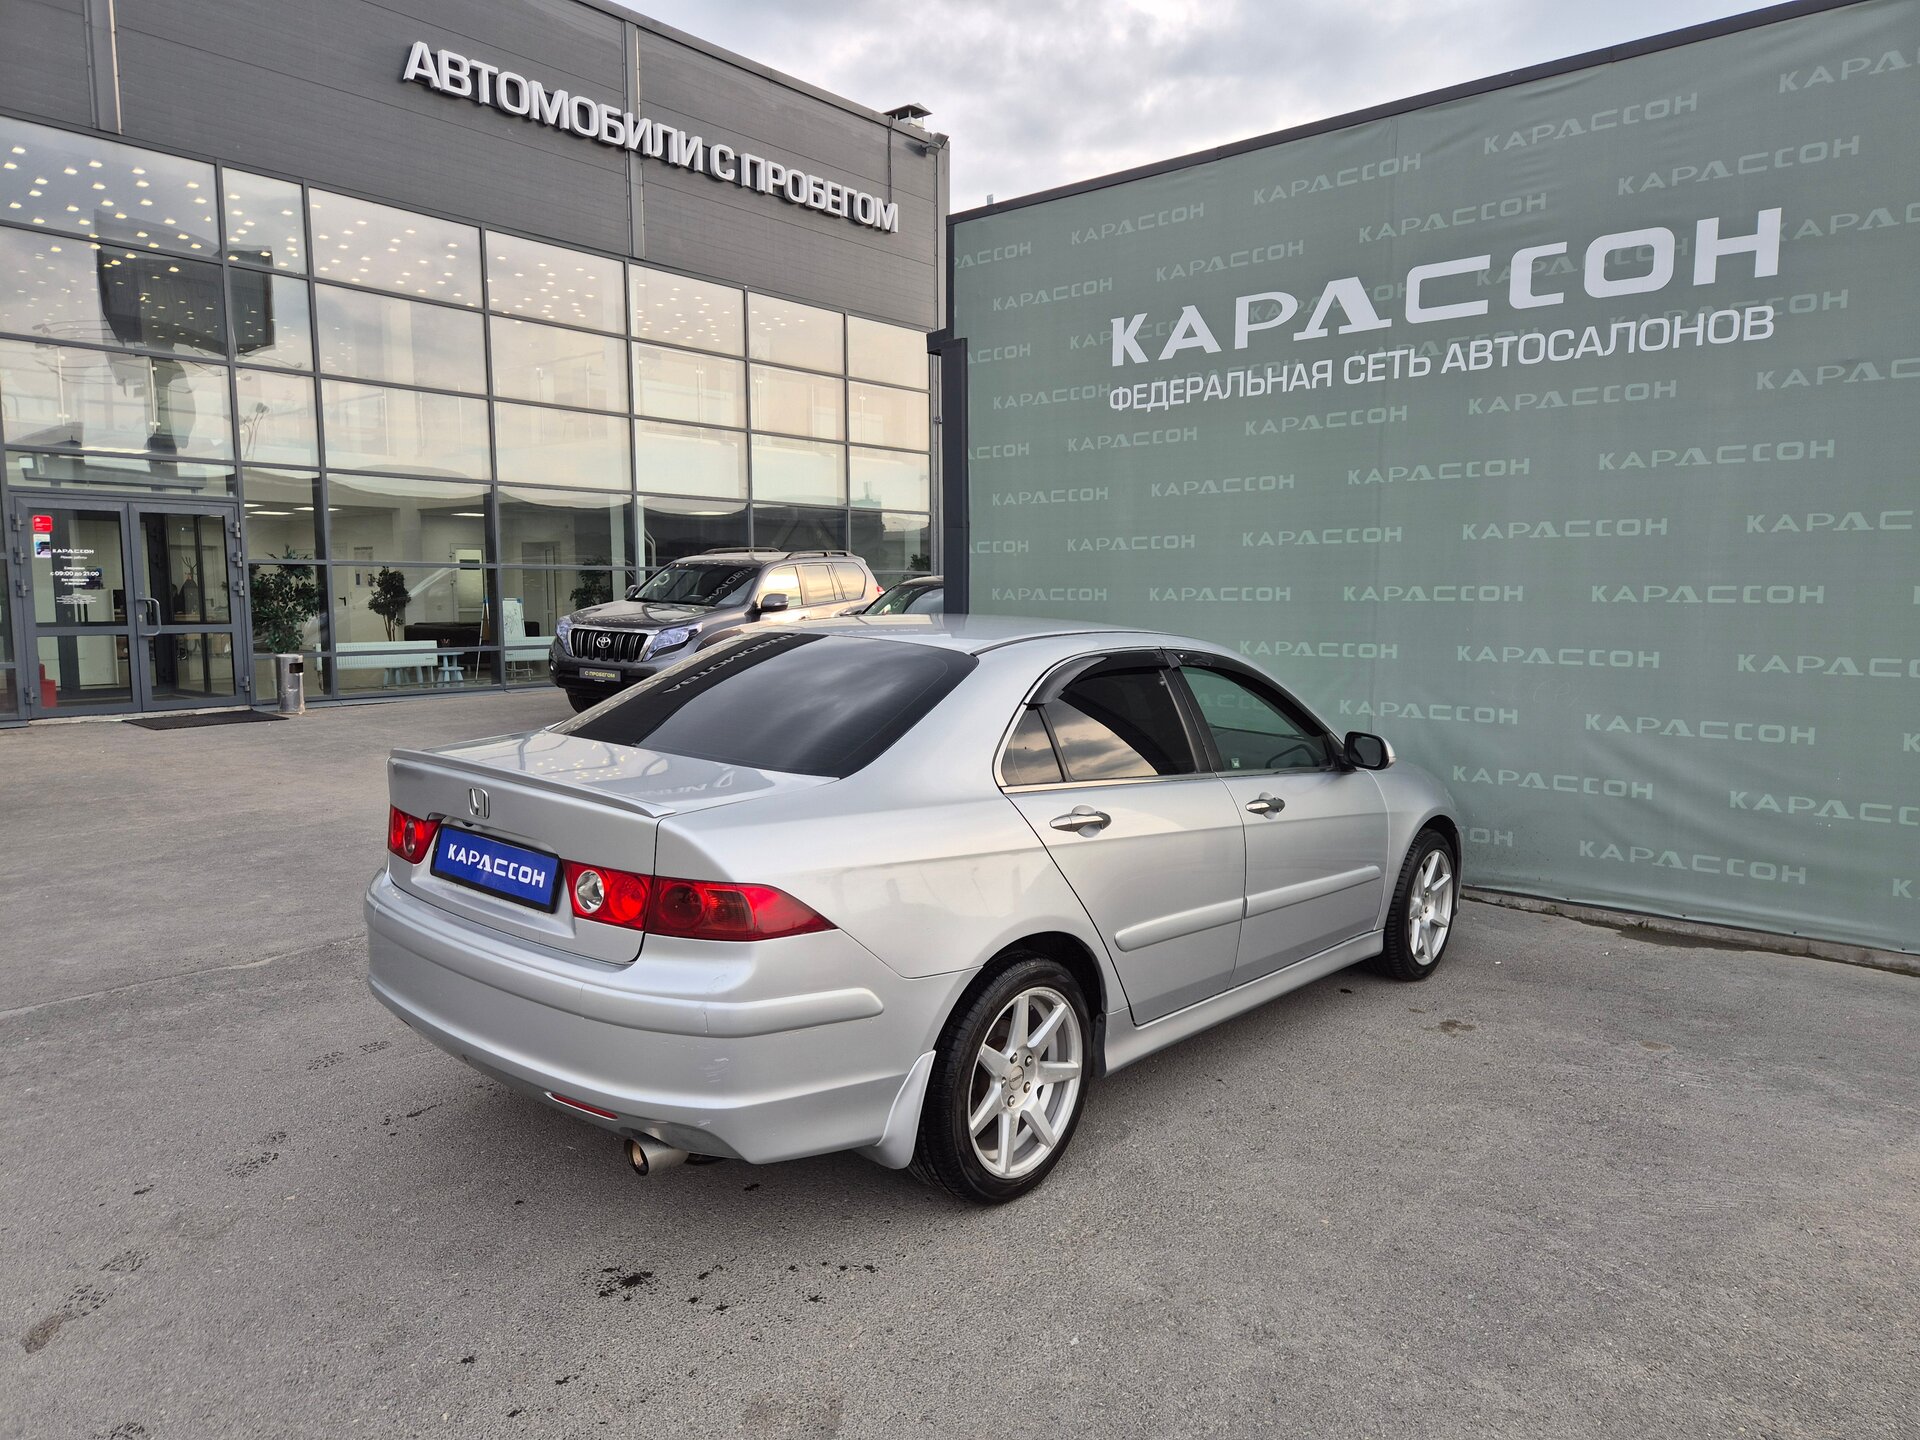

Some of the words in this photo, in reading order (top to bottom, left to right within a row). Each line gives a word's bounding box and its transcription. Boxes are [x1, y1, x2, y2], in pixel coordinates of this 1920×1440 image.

[1778, 49, 1920, 93] КАРА
[403, 41, 703, 172] АВТОМОБИЛИ
[709, 144, 735, 182] С
[740, 152, 899, 233] ПРОБЕГОМ
[954, 241, 1032, 268] АССОН
[1109, 360, 1332, 413] ФЕДЕРАЛЬНАЯ
[1343, 349, 1431, 385] СЕТЬ
[1440, 306, 1775, 374] АВТОСАЛОНОВ
[1756, 357, 1920, 391] КАРАС
[1746, 510, 1913, 534] КАРАС
[1738, 653, 1920, 679] КАРАСС
[1730, 790, 1920, 826] КАРАСС
